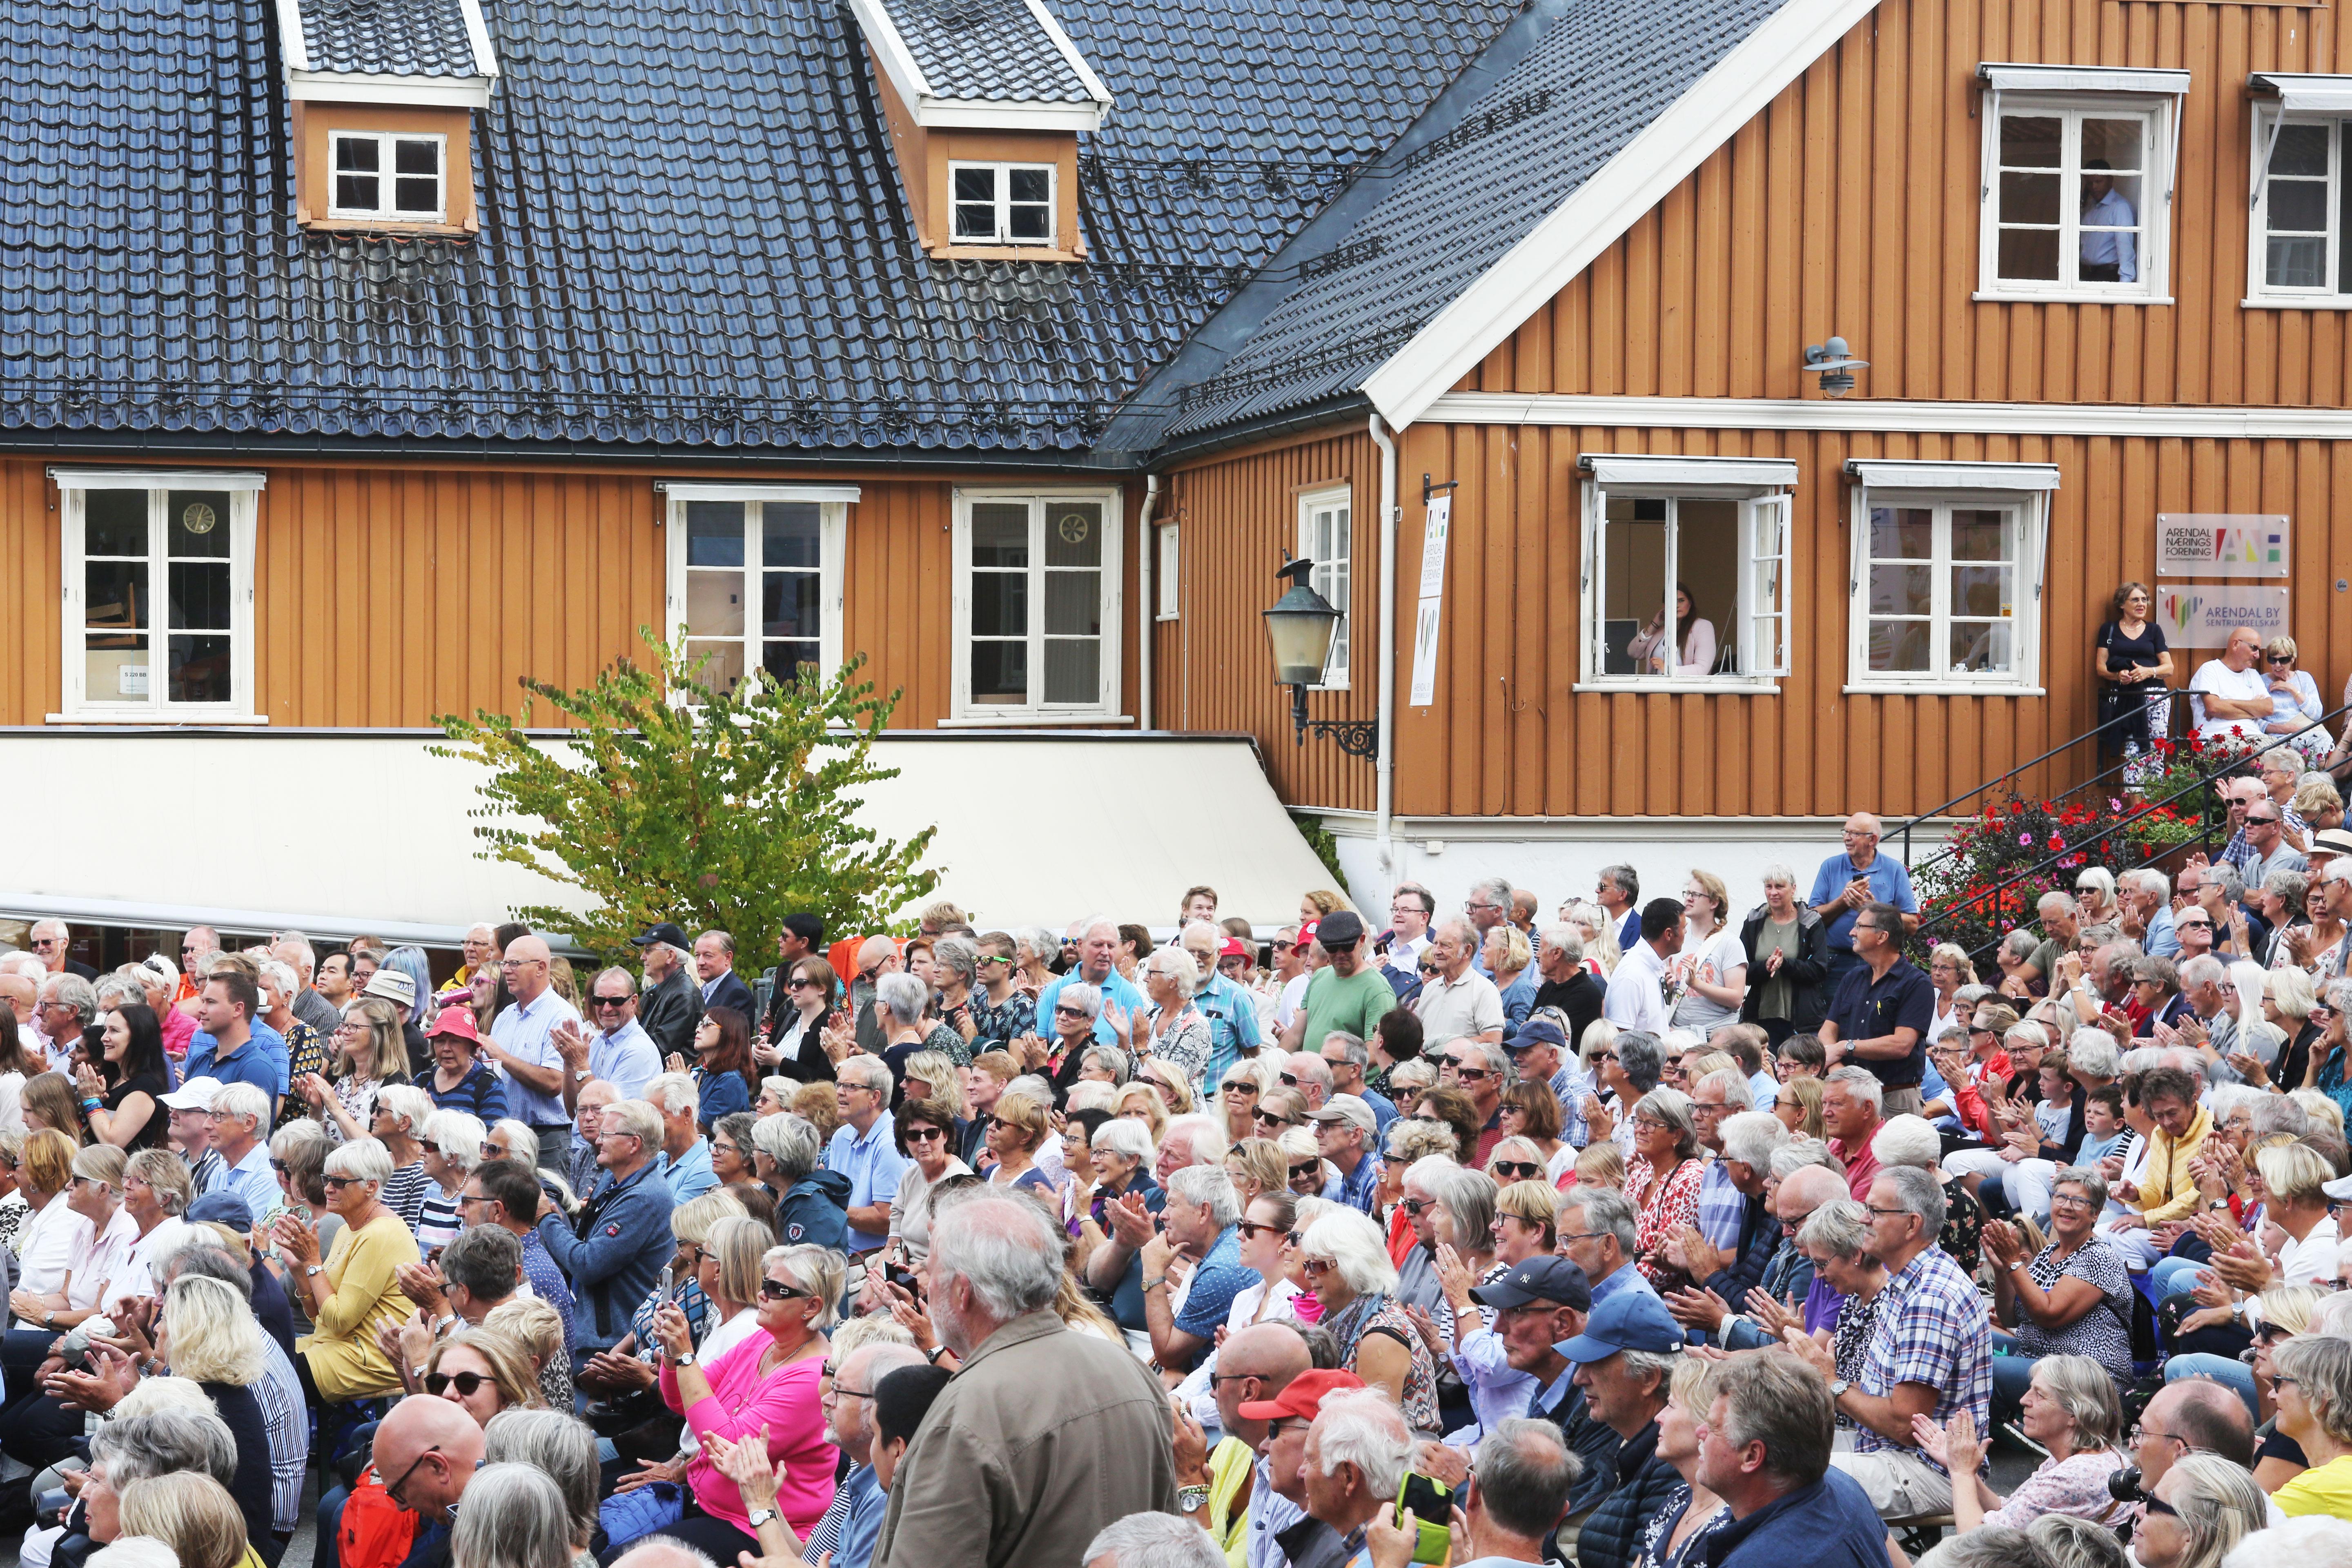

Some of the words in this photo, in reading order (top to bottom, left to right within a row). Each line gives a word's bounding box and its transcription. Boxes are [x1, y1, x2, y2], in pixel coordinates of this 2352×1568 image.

[2166, 528, 2212, 537] ARENDAL
[2166, 537, 2211, 546] NÆRINGS
[1426, 543, 1442, 555] ARENDAL
[2166, 547, 2212, 556] FORENING
[2206, 607, 2261, 618] ARENDAL
[2266, 607, 2281, 618] BY
[398, 981, 414, 993] DAG
